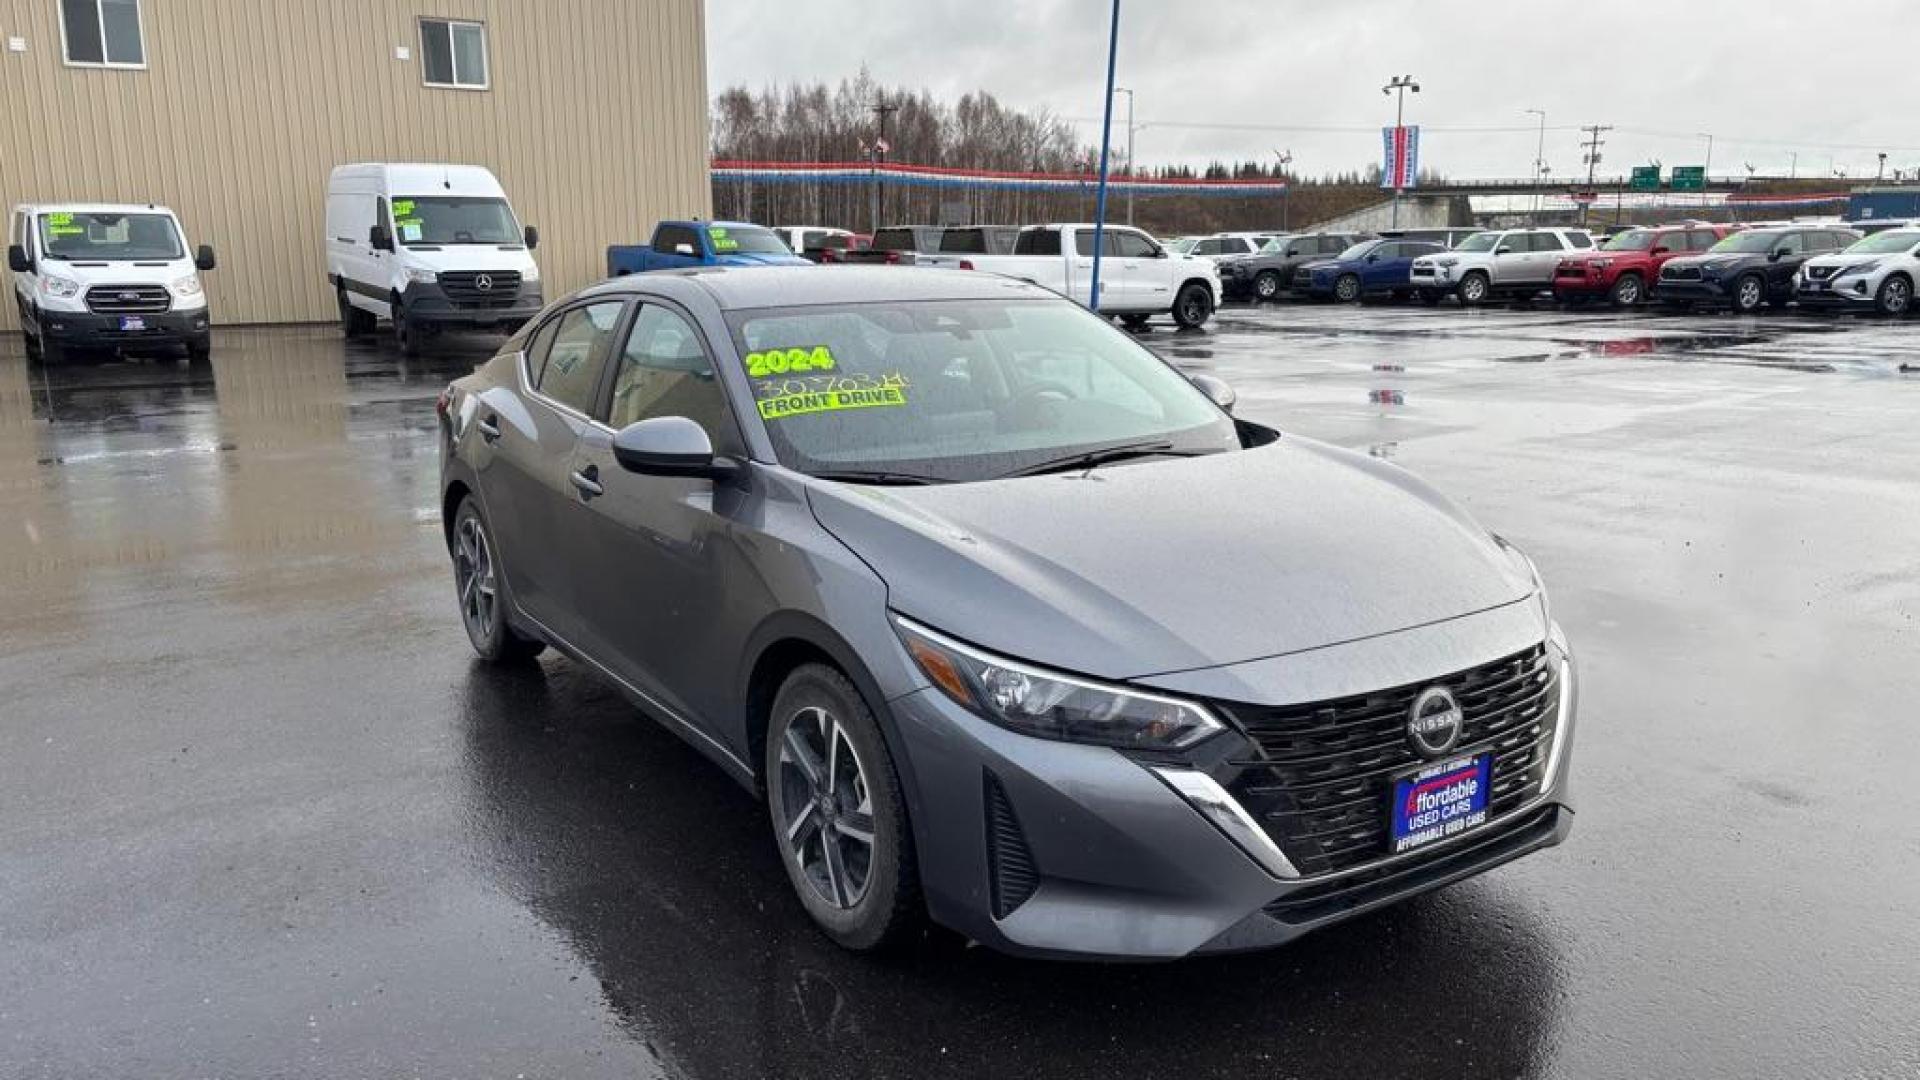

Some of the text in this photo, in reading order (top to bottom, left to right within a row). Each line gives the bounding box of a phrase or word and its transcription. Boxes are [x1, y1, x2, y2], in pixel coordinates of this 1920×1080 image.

[746, 346, 835, 376] 2024
[761, 388, 899, 416] FRONT DRIVE
[1411, 709, 1461, 735] NISSAN
[1405, 768, 1479, 818] Affordable
[1408, 797, 1471, 832] USED CARS
